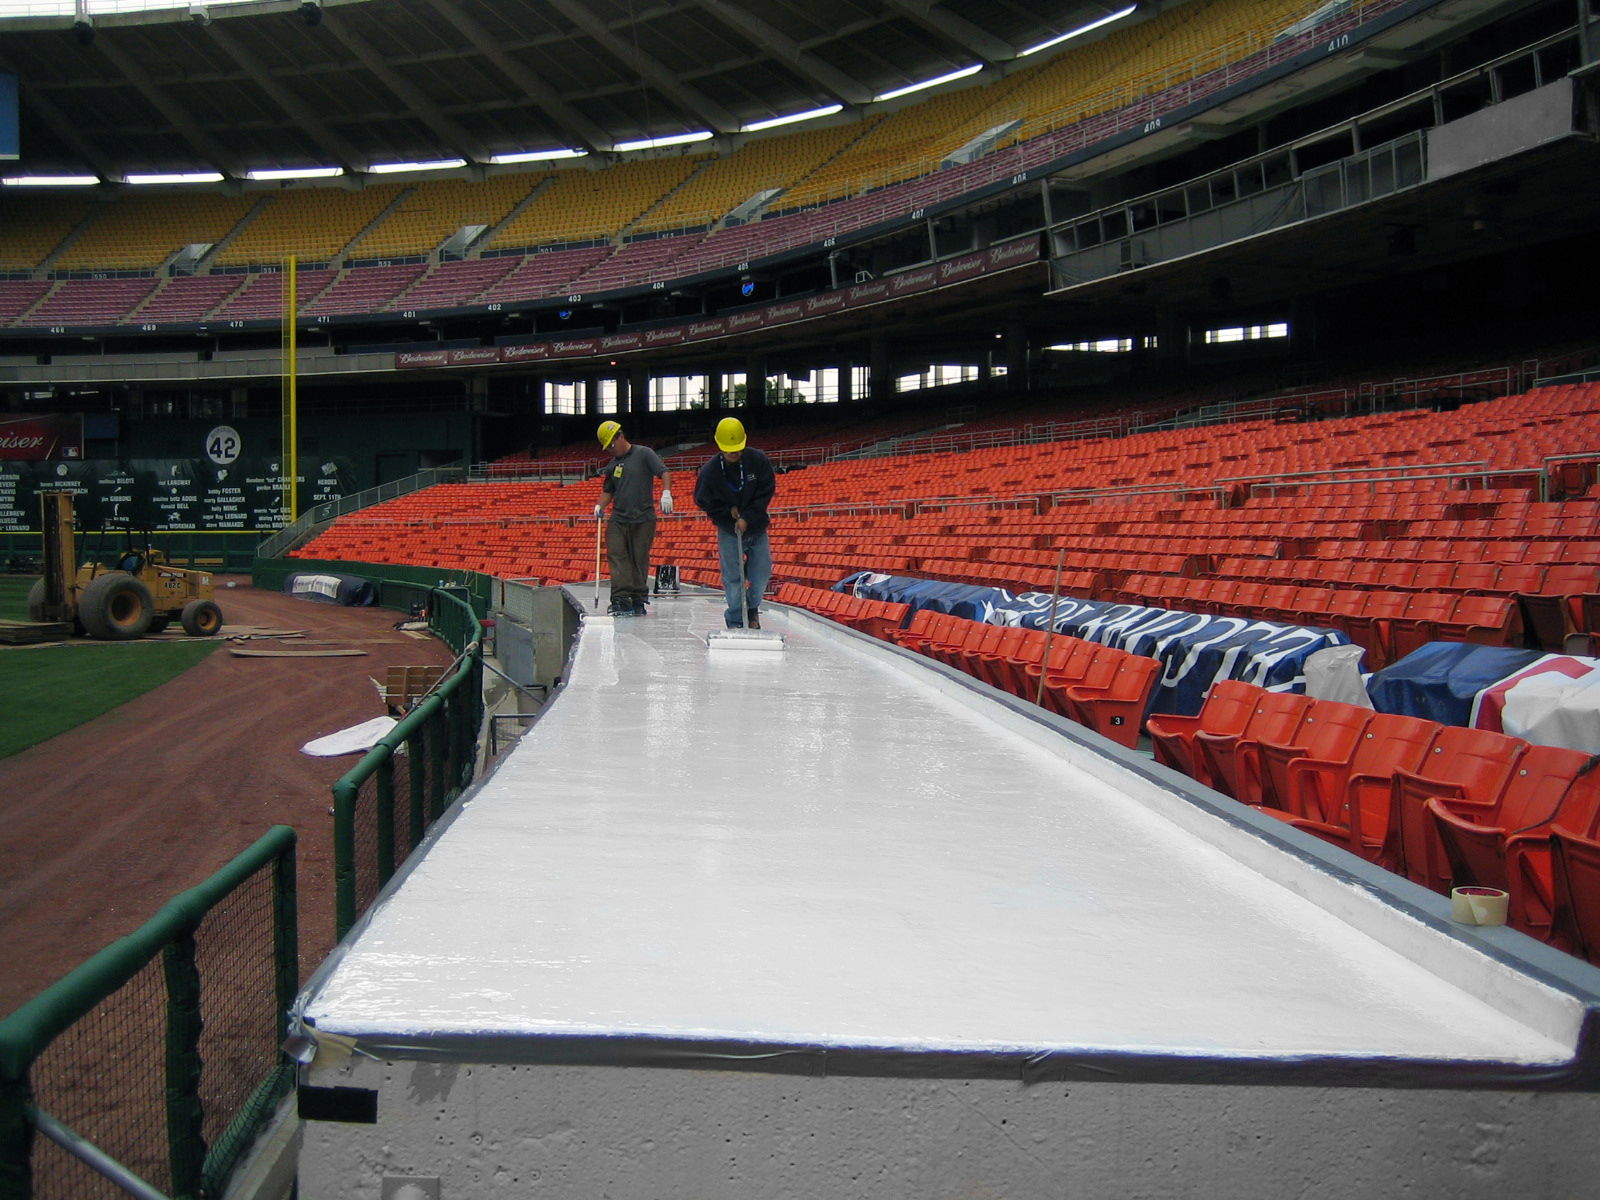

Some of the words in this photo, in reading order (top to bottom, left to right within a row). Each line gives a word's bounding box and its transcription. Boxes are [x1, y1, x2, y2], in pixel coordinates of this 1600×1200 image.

[1328, 34, 1348, 52] 410
[1144, 118, 1161, 133] 409
[911, 209, 924, 219] 407
[990, 243, 1035, 263] Budweiser
[941, 258, 982, 277] Budweiser
[652, 282, 665, 290] 404
[894, 272, 933, 289] Budweiser
[850, 284, 886, 299] Budweiser
[568, 294, 581, 302] 403
[806, 295, 842, 311] Budweiser
[487, 303, 502, 311] 402
[767, 305, 800, 318] Budweiser
[728, 314, 761, 327] Budweiser
[689, 322, 722, 335] Budweiser
[601, 336, 638, 348] Budweiser
[645, 330, 681, 342] Budweiser
[504, 346, 545, 357] Budweiser
[553, 341, 593, 353] Budweiser
[400, 353, 444, 363] Budweiser
[452, 350, 496, 361] Budweiser
[209, 437, 236, 458] 42
[1114, 717, 1121, 725] 3
